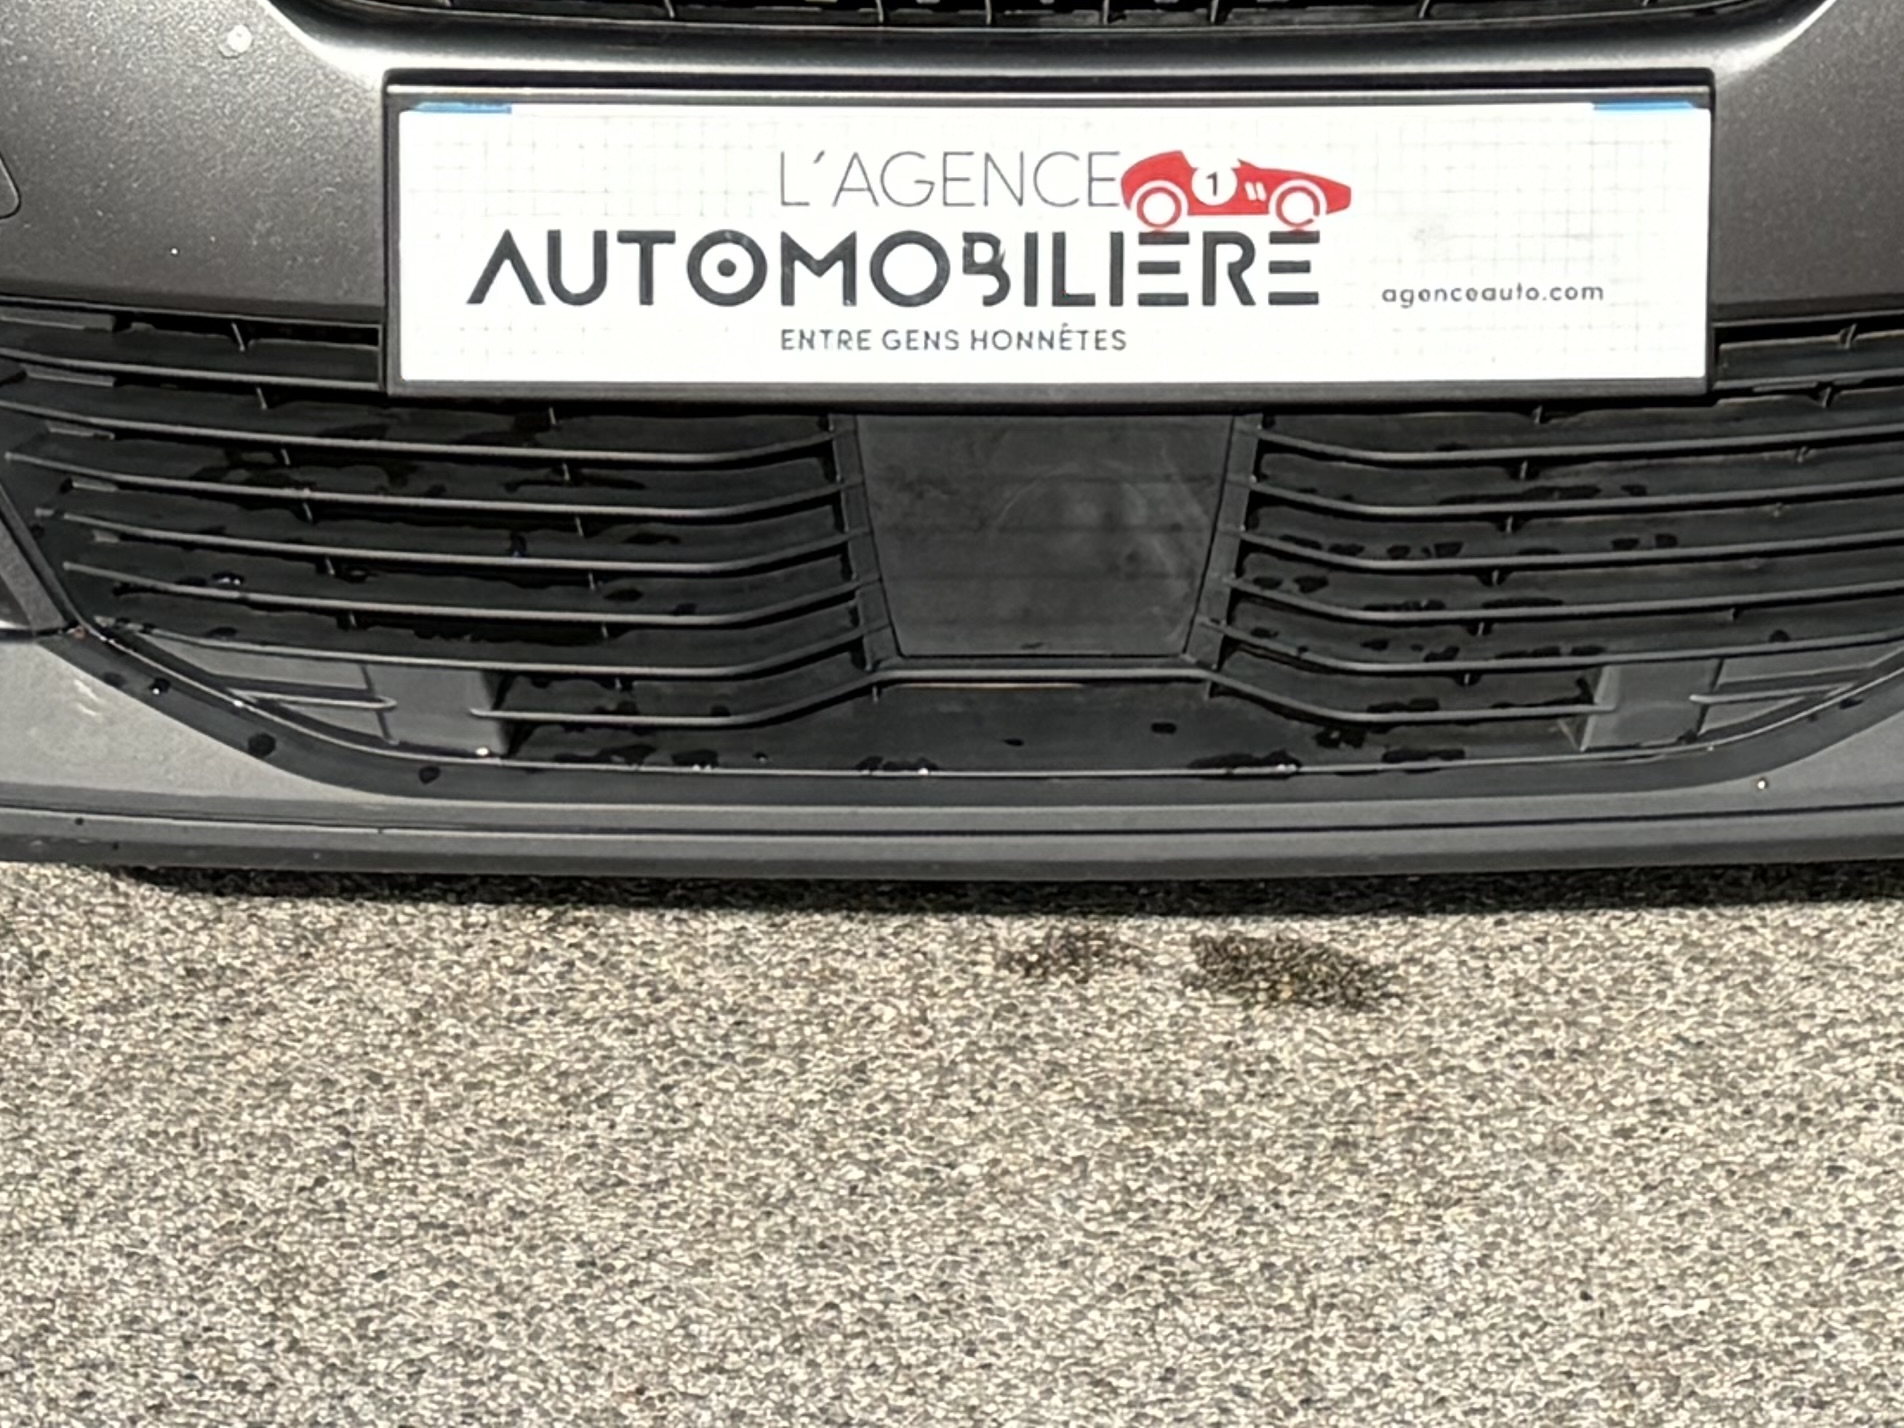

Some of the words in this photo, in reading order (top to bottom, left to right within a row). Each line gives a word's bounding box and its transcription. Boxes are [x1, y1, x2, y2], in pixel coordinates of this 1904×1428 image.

[779, 150, 1121, 208] L'AGENCE
[1205, 170, 1219, 197] 1
[1381, 281, 1605, 309] agenceauto.com
[780, 328, 873, 351] ENTRE
[881, 328, 960, 351] GENS
[969, 322, 1128, 352] HONNÊTES
